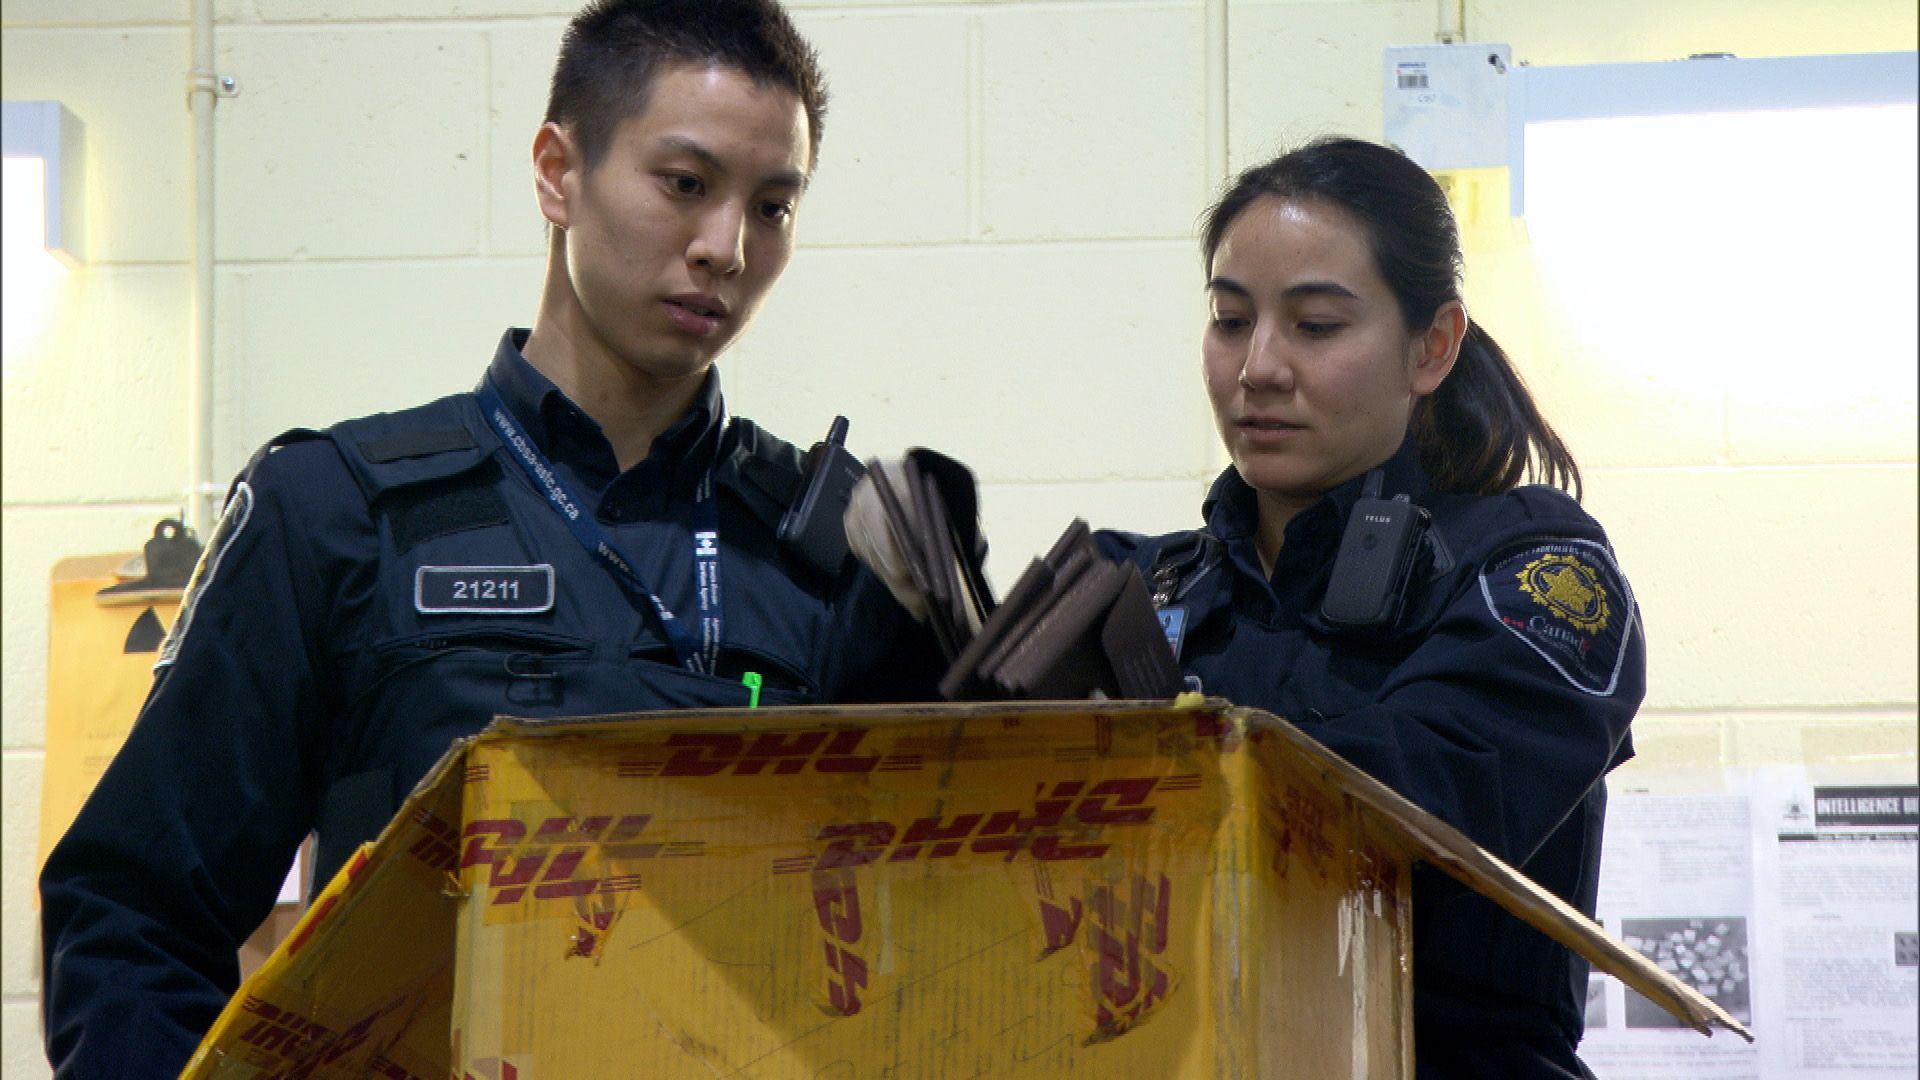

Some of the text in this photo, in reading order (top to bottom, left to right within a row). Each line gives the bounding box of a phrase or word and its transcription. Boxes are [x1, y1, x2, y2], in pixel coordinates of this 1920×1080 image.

[1365, 514, 1391, 524] TELUS
[453, 579, 519, 599] 21211
[661, 730, 880, 776] DHL
